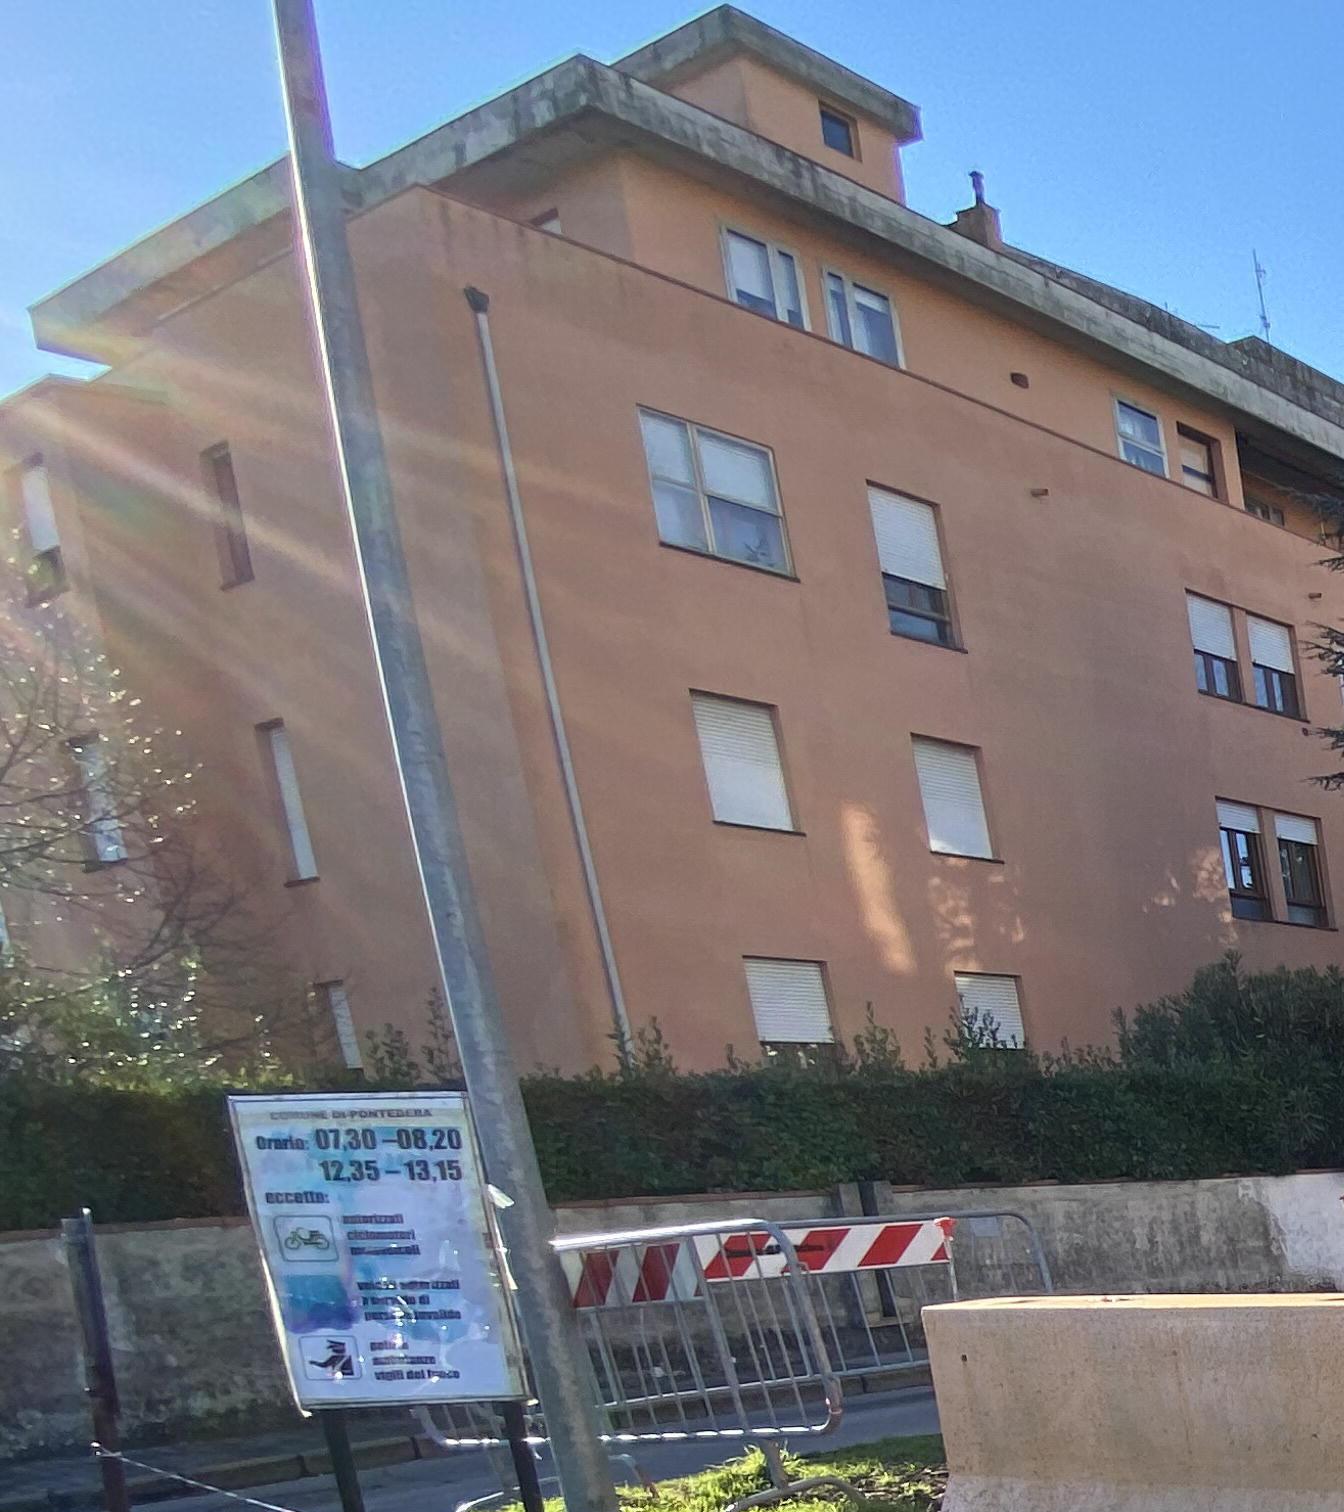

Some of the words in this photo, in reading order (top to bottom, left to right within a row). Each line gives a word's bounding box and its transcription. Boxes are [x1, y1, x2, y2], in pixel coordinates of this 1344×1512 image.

[315, 1128, 377, 1152] 07,30
[318, 1159, 381, 1182] 12,35
[404, 1159, 463, 1183] 13,15
